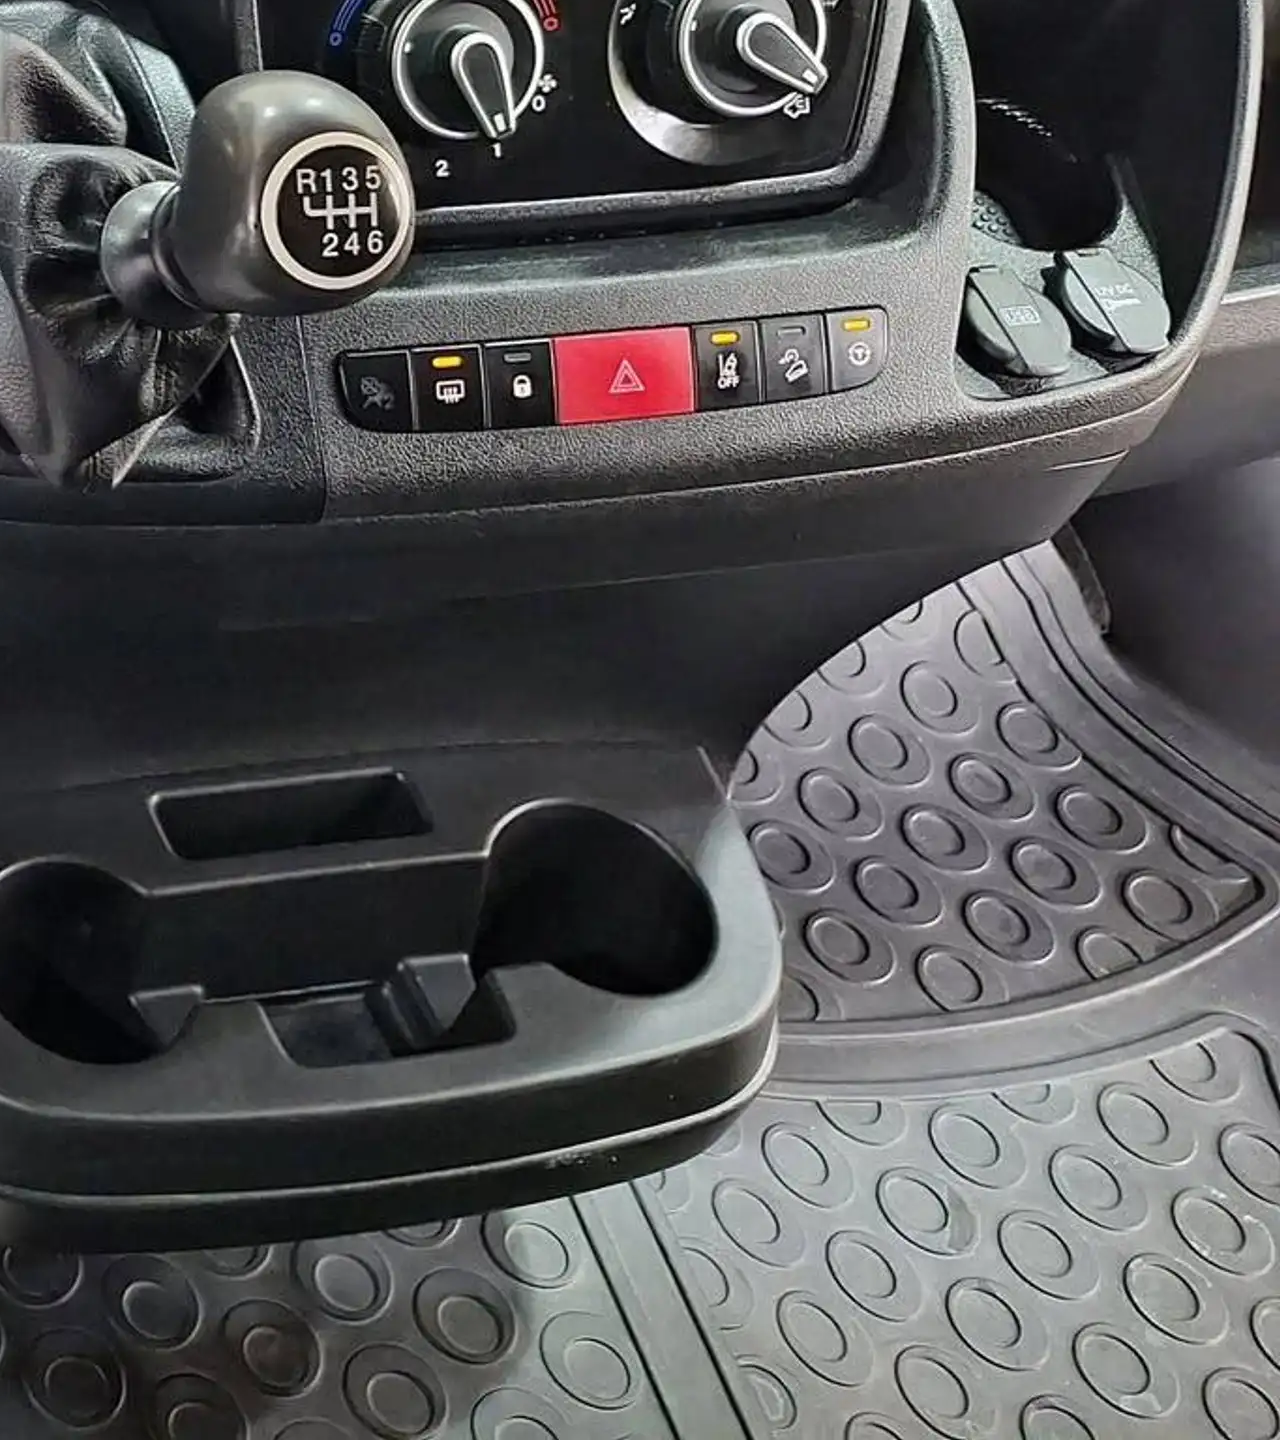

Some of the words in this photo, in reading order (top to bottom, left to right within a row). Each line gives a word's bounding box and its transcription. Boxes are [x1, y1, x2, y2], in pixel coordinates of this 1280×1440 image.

[491, 142, 502, 158] 1
[435, 160, 450, 177] 2
[296, 168, 317, 194] R
[717, 374, 740, 389] OFF
